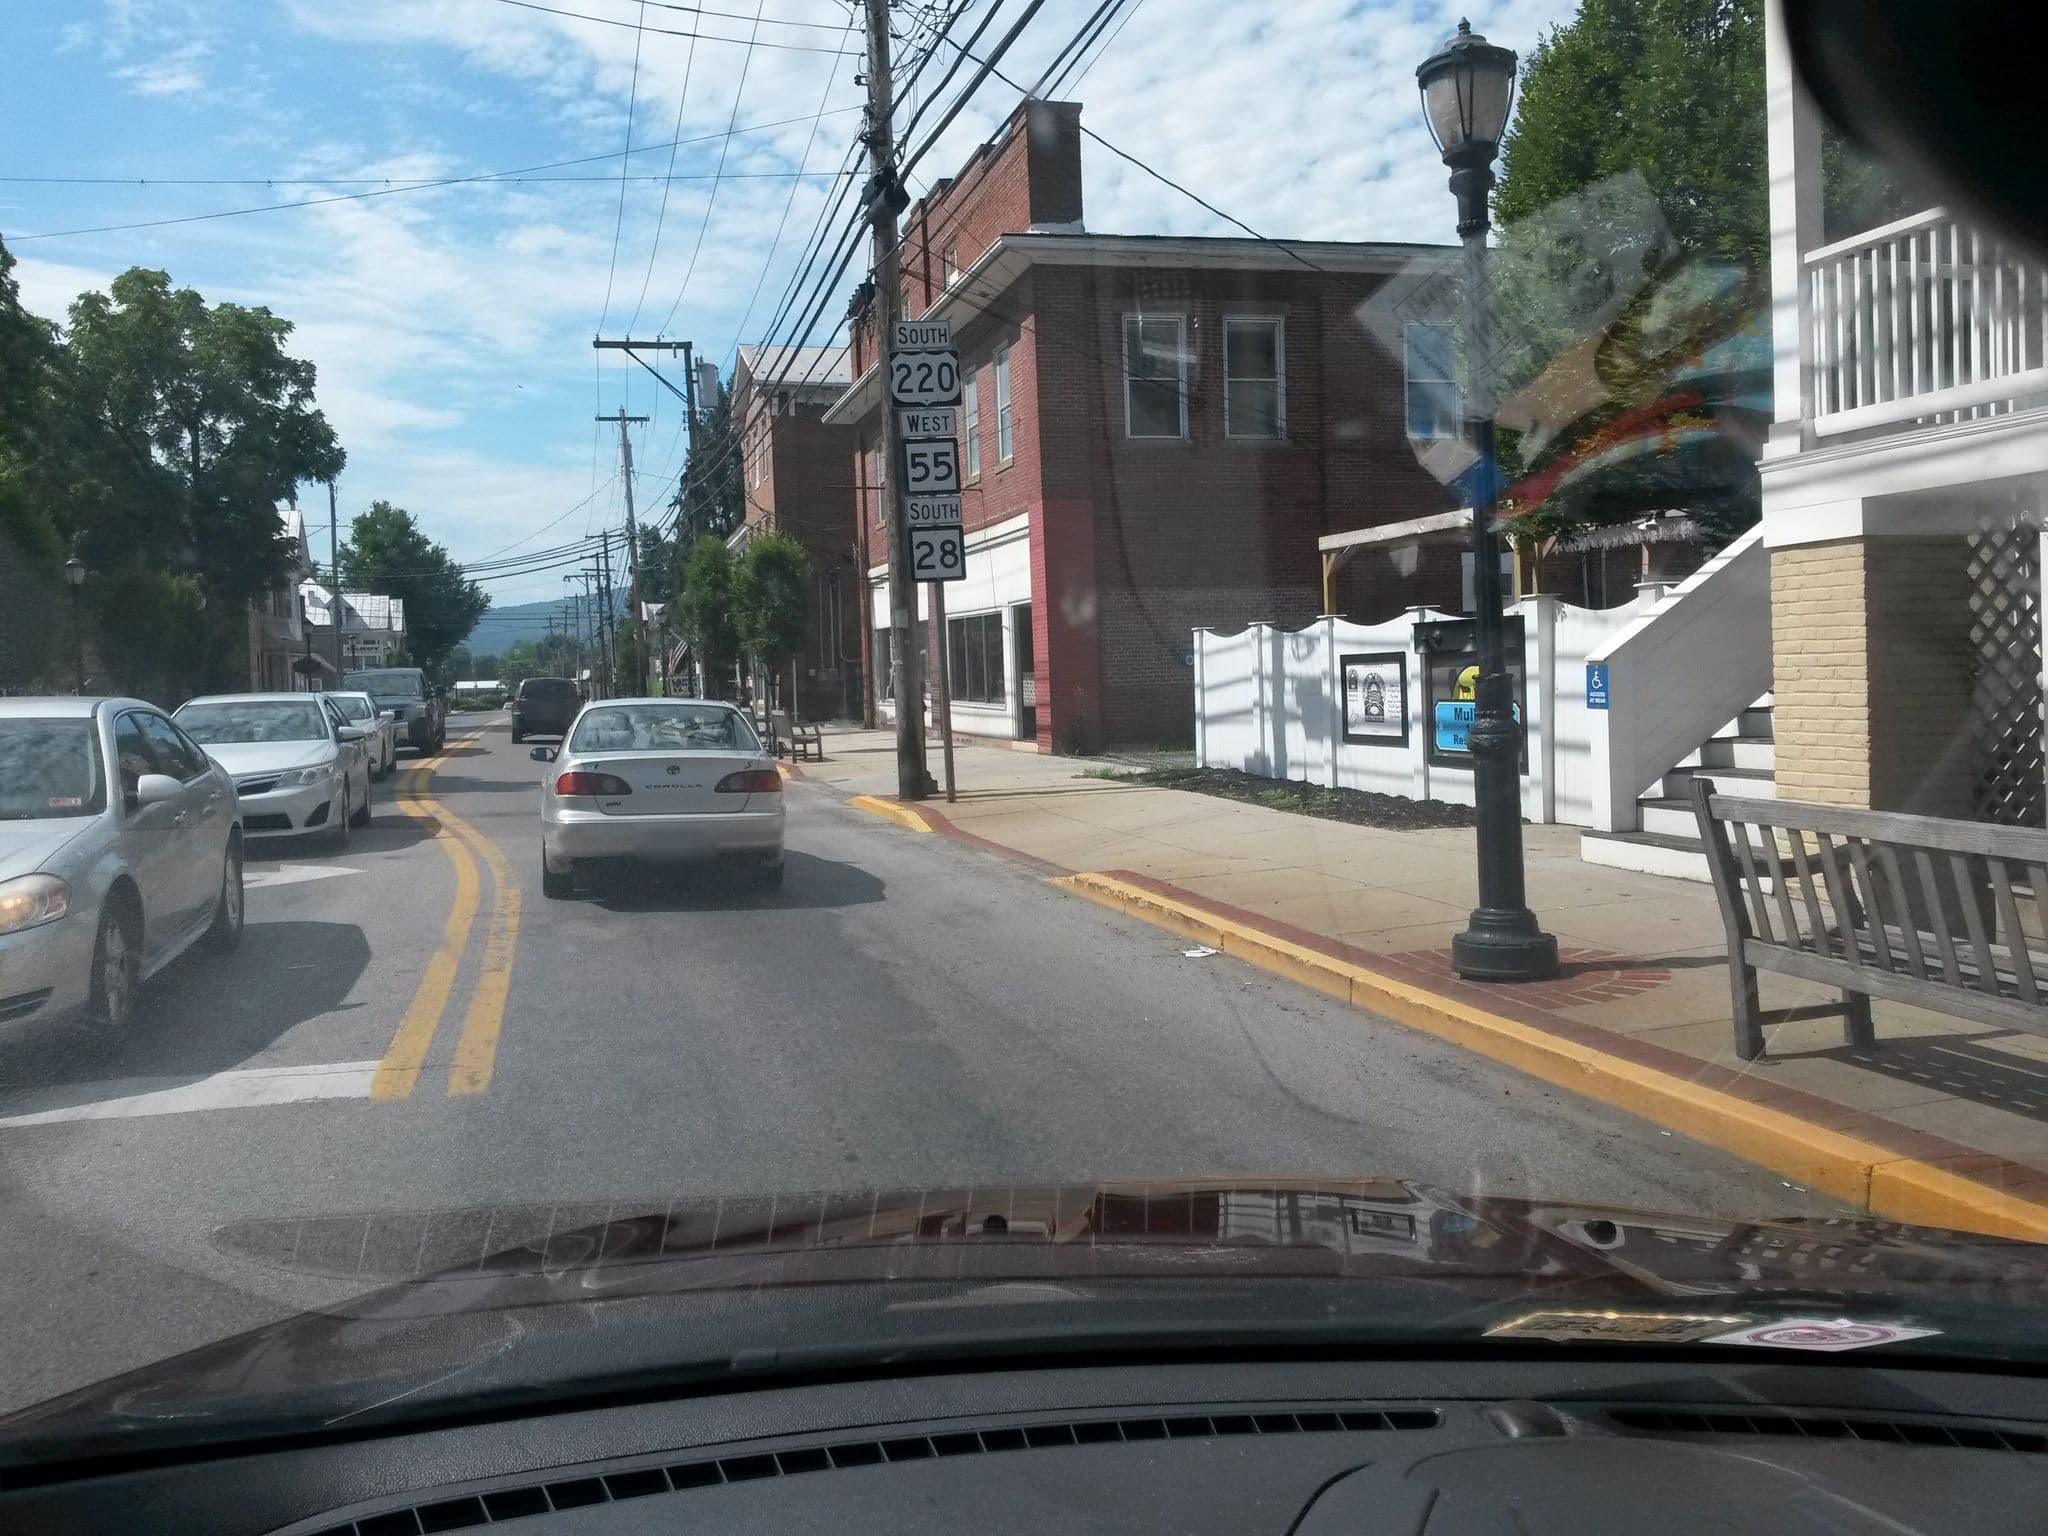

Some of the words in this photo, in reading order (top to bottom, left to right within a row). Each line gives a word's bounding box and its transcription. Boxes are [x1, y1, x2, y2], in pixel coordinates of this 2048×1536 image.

[898, 326, 948, 344] SOUTH
[895, 363, 955, 393] 220
[906, 414, 949, 432] WEST
[910, 452, 953, 482] 55
[910, 503, 959, 520] SOUTH
[915, 539, 959, 570] 28
